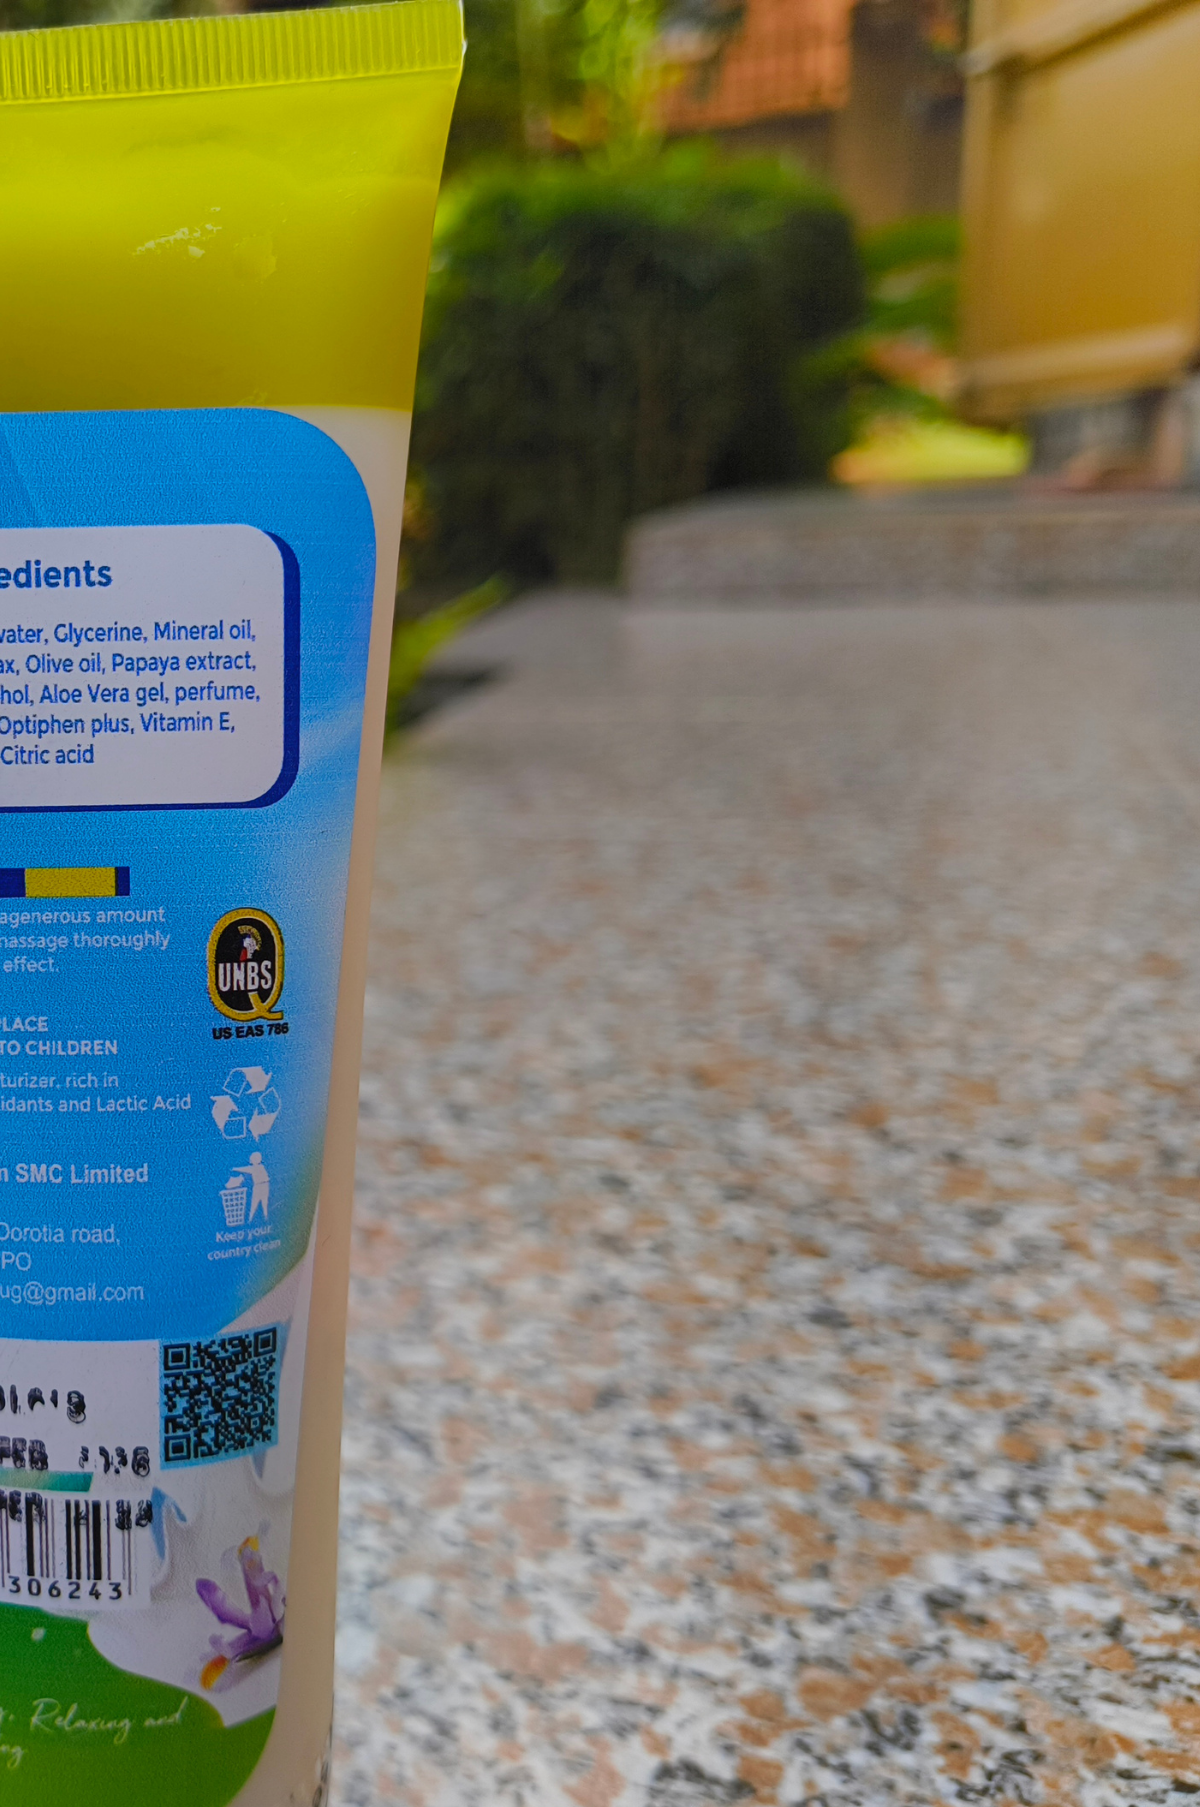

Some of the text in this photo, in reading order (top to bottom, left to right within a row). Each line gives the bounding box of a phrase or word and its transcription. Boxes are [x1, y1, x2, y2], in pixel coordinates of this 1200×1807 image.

[54, 621, 148, 647] Glycerine,
[154, 620, 224, 641] Mineral
[229, 619, 256, 641] oil,
[25, 654, 74, 674] Olive
[79, 653, 106, 675] oil,
[112, 653, 180, 676] Papaya
[185, 651, 256, 671] extract,
[39, 684, 82, 704] Aloe
[87, 684, 130, 703] Vera
[136, 682, 169, 707] gel,
[175, 681, 260, 706] perfume,
[91, 713, 135, 737] plus,
[140, 712, 213, 733] Vitamin
[219, 712, 235, 733] E,
[0, 745, 50, 766] Citric
[55, 744, 95, 764] acid
[0, 911, 91, 928] agenerous
[96, 906, 166, 924] amount
[73, 930, 170, 950] thoroughly
[3, 956, 59, 973] effect.
[218, 960, 272, 992] UNBS
[212, 1022, 289, 1040] US EAS 786
[25, 1040, 118, 1056] CHILDREN
[65, 1072, 99, 1088] rich
[103, 1072, 119, 1088] in
[58, 1096, 91, 1112] and
[96, 1095, 148, 1112] Lactic
[152, 1093, 192, 1111] Acid
[15, 1163, 63, 1184] SMC
[70, 1162, 149, 1184] Limited
[9, 1575, 123, 1600] 306243
[30, 1697, 131, 1745] Relaxing
[143, 1695, 189, 1728] and
